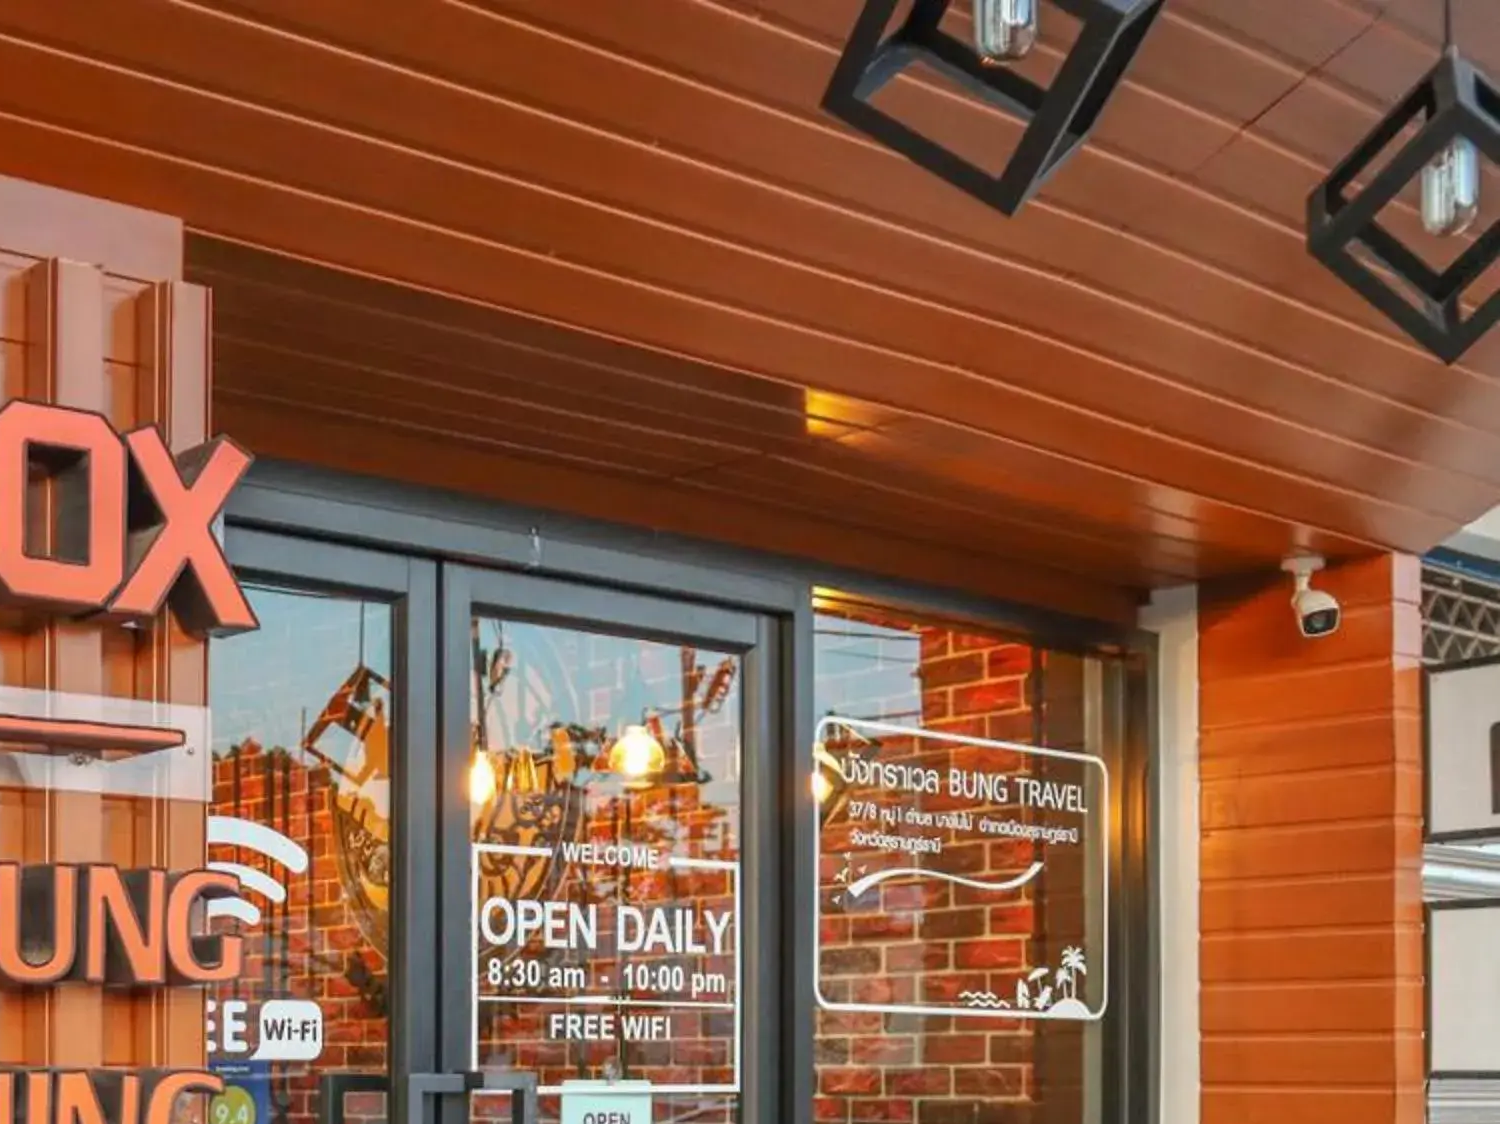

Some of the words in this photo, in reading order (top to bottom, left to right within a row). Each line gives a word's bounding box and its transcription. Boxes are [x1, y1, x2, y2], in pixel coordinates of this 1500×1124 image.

[949, 767, 1008, 803] BUNG
[1014, 777, 1088, 813] TRAVEL
[561, 841, 659, 869] WELCOME
[480, 896, 597, 949] OPEN
[617, 904, 732, 955] DAILY
[487, 958, 541, 987] 8:30
[549, 966, 585, 989] am
[623, 963, 684, 992] 10:00
[690, 972, 726, 998] pm
[263, 1018, 317, 1042] Wi-Fi
[550, 1014, 615, 1041] FREE
[622, 1015, 671, 1041] WIFI
